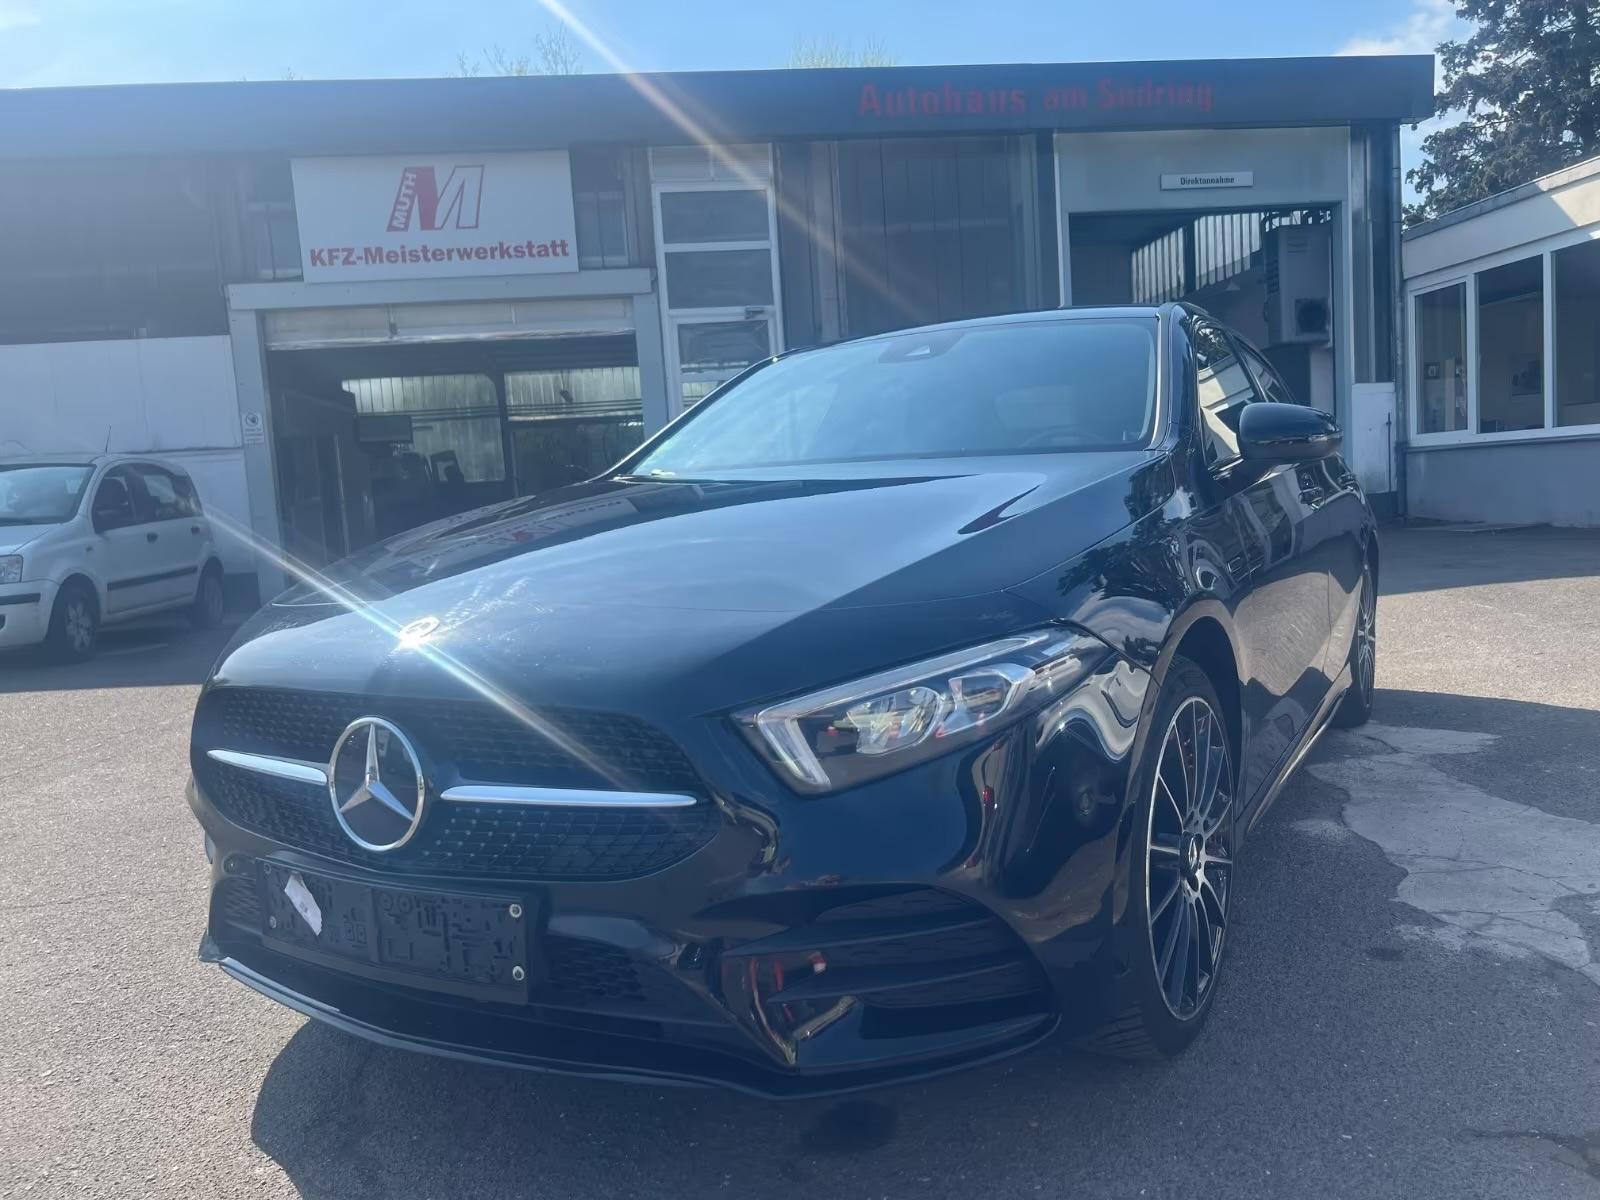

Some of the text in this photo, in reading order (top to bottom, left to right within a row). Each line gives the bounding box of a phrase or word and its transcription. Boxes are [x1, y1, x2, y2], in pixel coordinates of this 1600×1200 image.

[858, 82, 1026, 117] Autohaus
[1043, 86, 1088, 111] am
[1180, 175, 1235, 186] Direktannahme
[391, 172, 417, 229] MUTH
[309, 239, 570, 267] KFZ-Meisterwerkstatt
